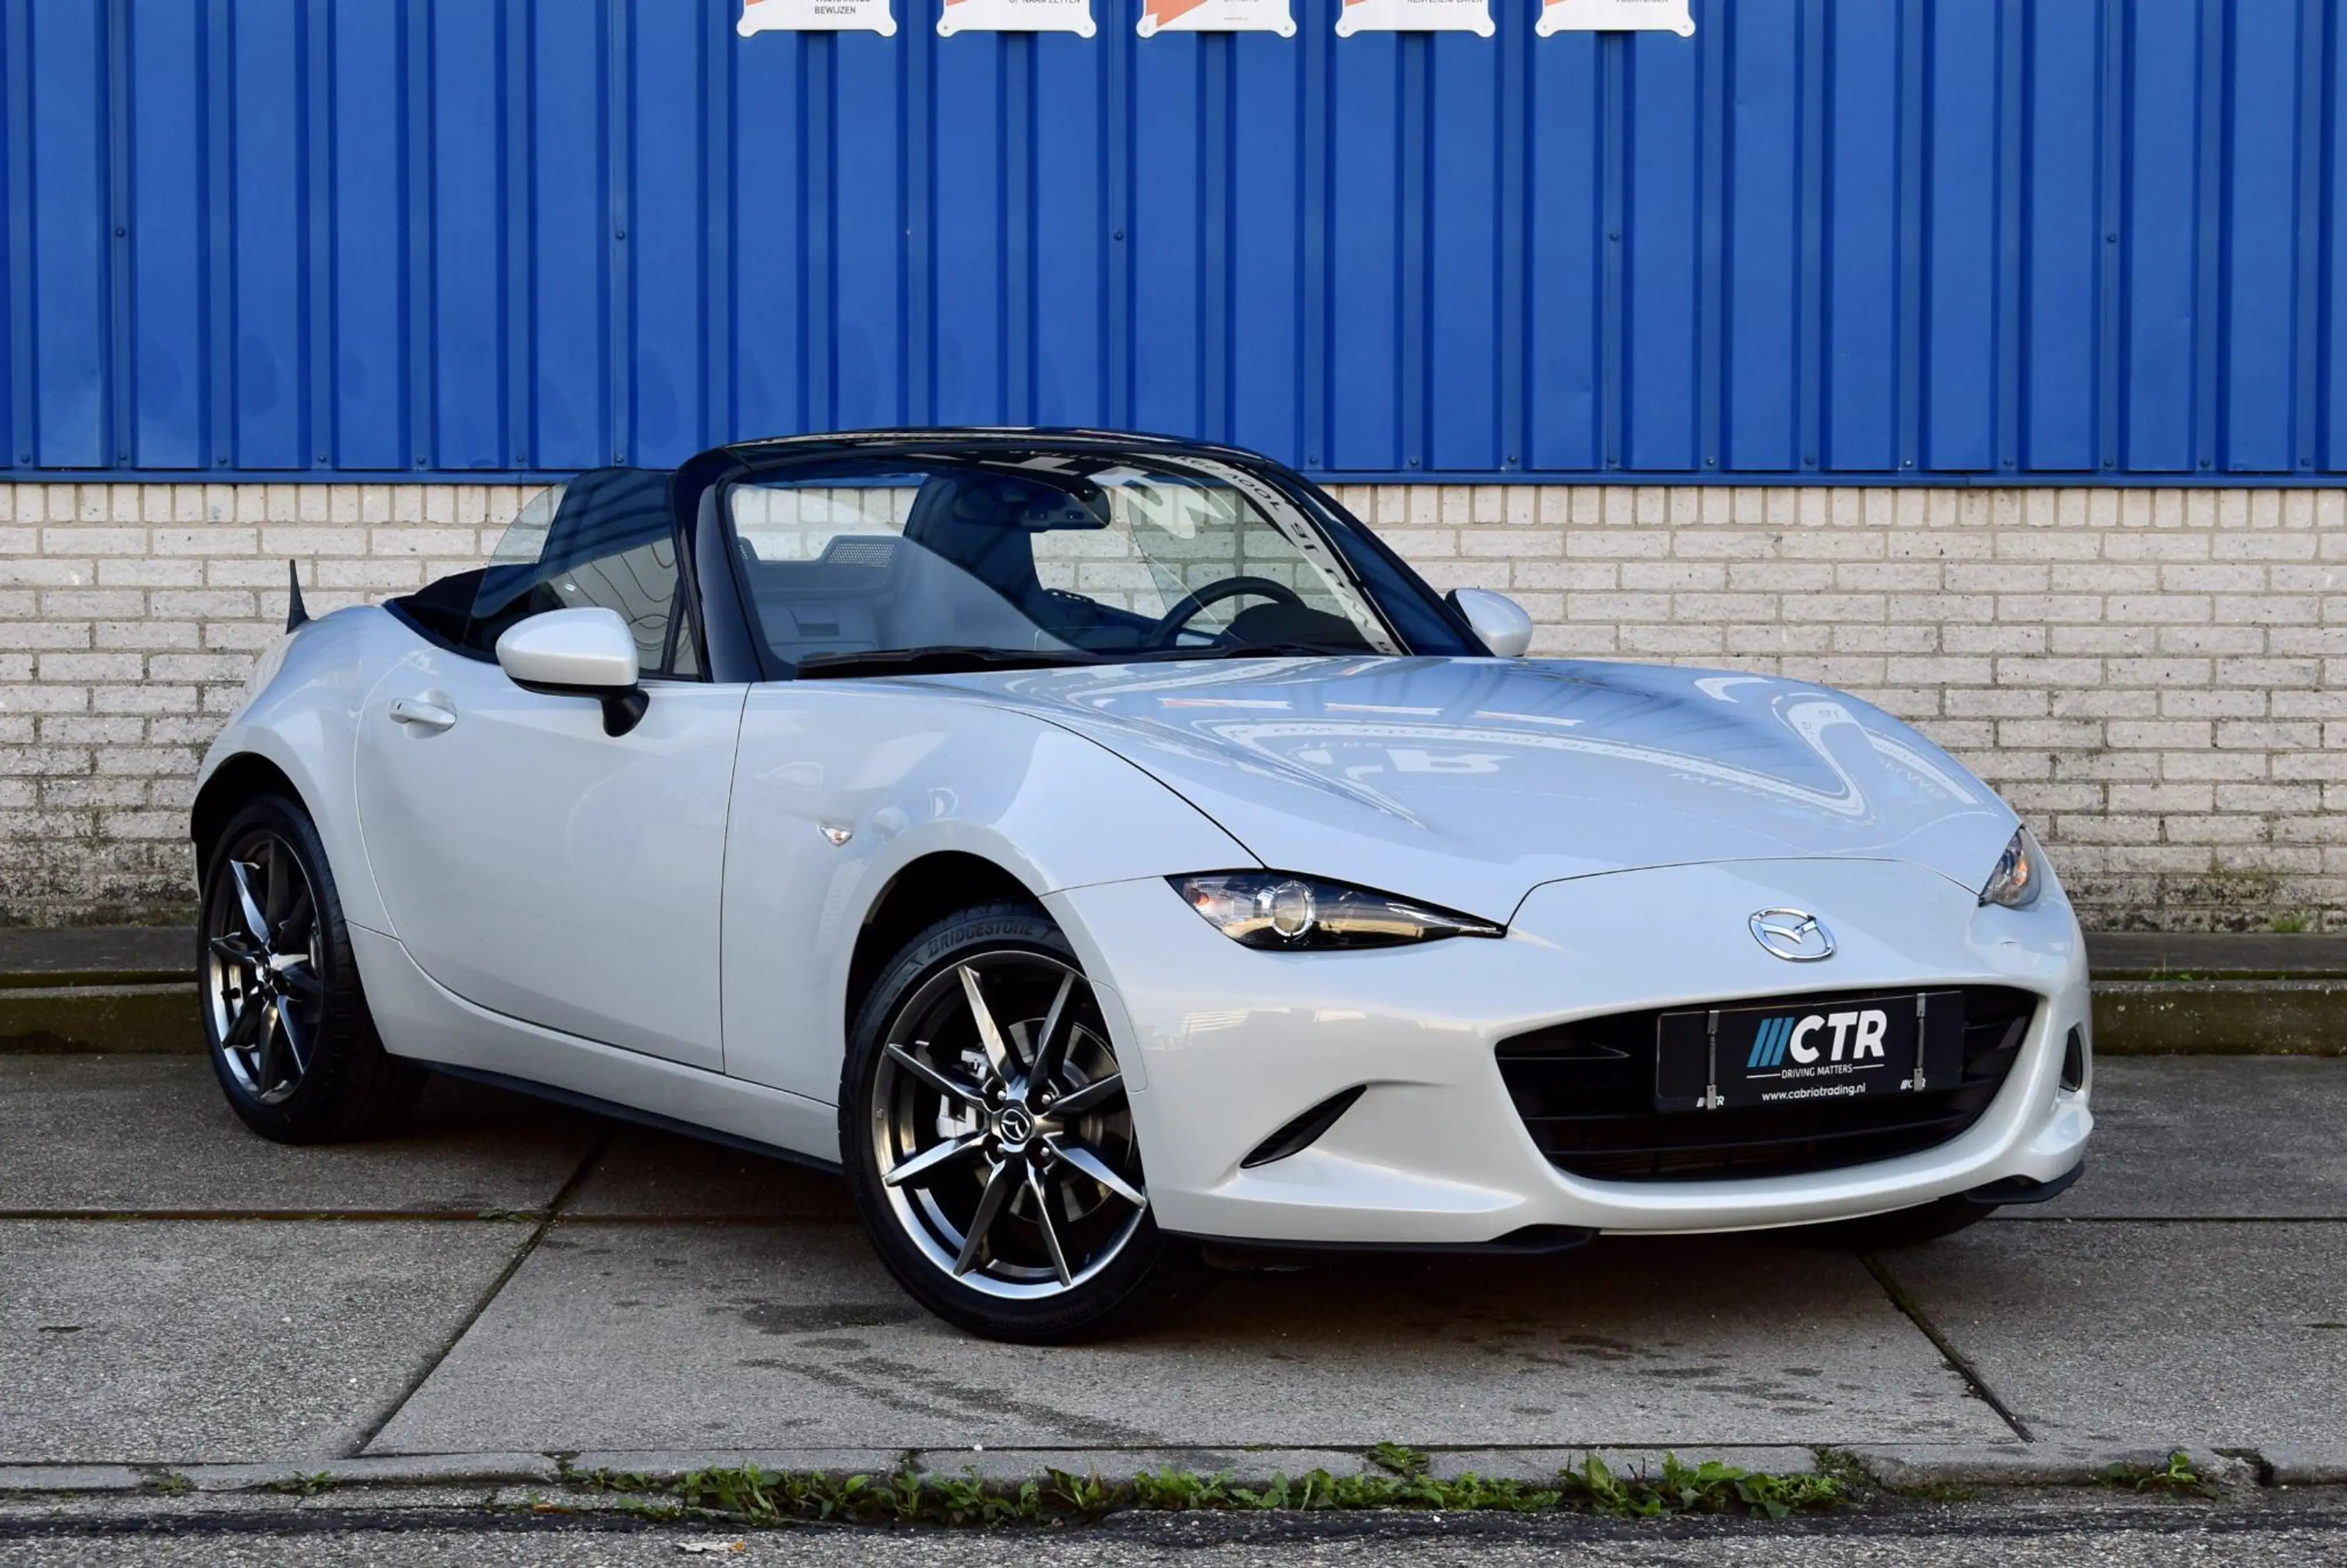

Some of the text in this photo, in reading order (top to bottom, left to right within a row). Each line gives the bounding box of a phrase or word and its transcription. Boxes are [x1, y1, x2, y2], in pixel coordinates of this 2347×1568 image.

[815, 5, 856, 14] BEWIJZEN
[927, 921, 1034, 958] BRIDGESTONE
[1790, 1009, 1887, 1064] CTR
[1781, 1063, 1853, 1079] DRIVING MATTERS
[1762, 1083, 1866, 1102] www.cabriotrading.nl
